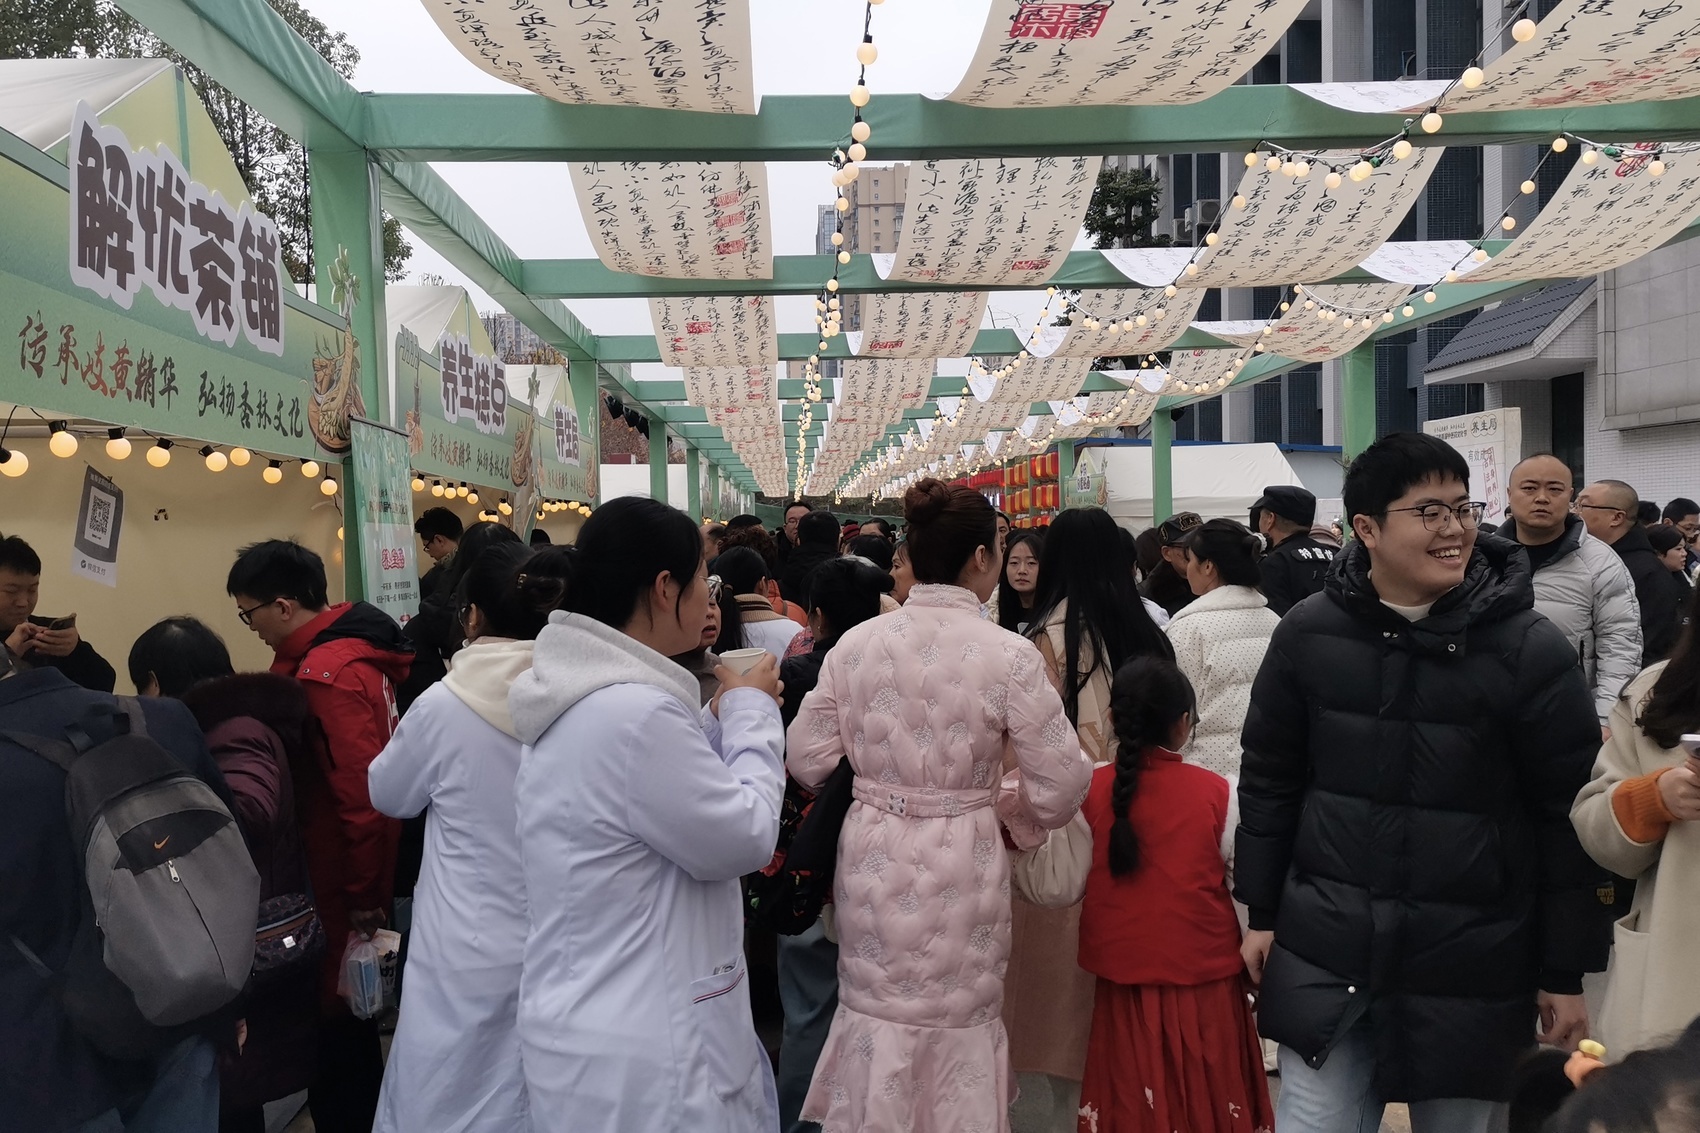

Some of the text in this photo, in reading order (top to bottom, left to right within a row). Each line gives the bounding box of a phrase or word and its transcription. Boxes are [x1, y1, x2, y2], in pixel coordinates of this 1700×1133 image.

[76, 119, 282, 344] 解忧茶铺
[17, 309, 304, 439] 传承岐黄精华 弘扬杏林文化
[441, 338, 506, 428] 养生糕点
[554, 404, 580, 460] 养生局
[1470, 417, 1498, 435] 养生局
